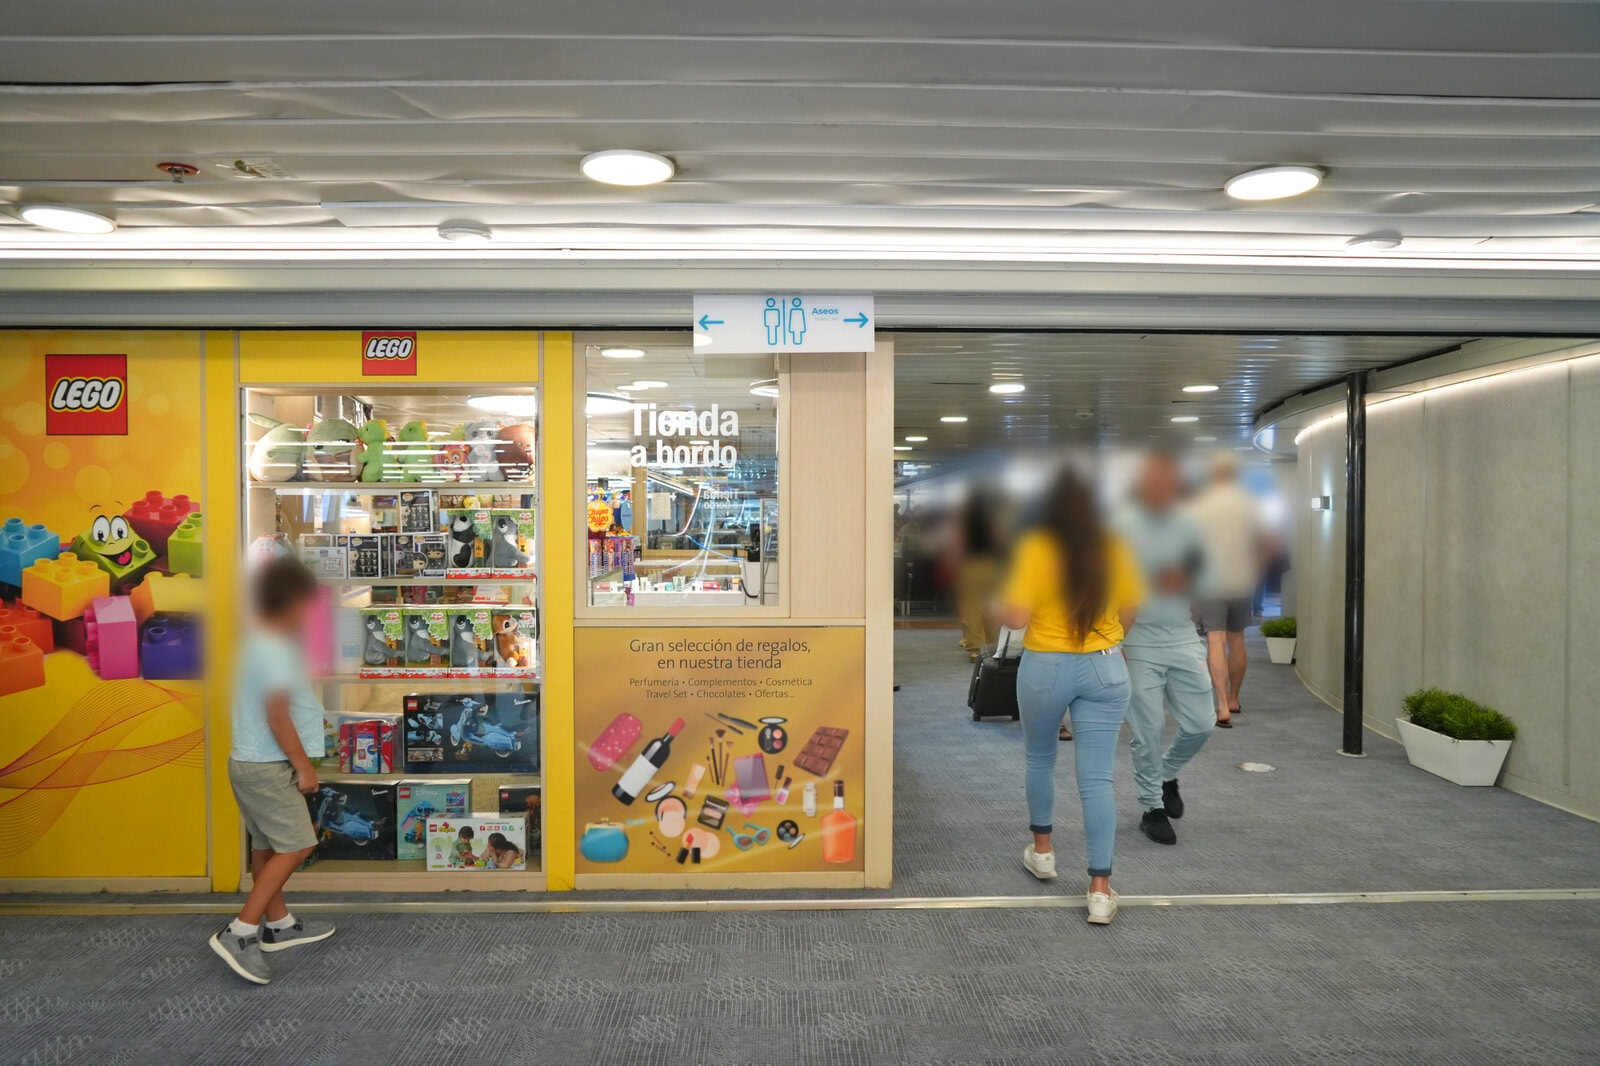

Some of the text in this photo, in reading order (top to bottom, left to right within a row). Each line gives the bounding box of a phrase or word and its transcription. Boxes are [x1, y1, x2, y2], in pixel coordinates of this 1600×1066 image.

[811, 307, 839, 315] Aseos
[365, 337, 414, 360] LEGO
[51, 378, 124, 411] LEGO
[629, 403, 739, 437] Tienda
[631, 440, 738, 468] a bordo
[629, 638, 811, 656] Gran selección de regalos,
[657, 655, 782, 669] en nuestra tienda
[629, 678, 813, 688] Perfumería Complementos Cosmética
[645, 690, 671, 698] Travel
[673, 690, 687, 698] Set
[696, 689, 746, 698] Chocolates
